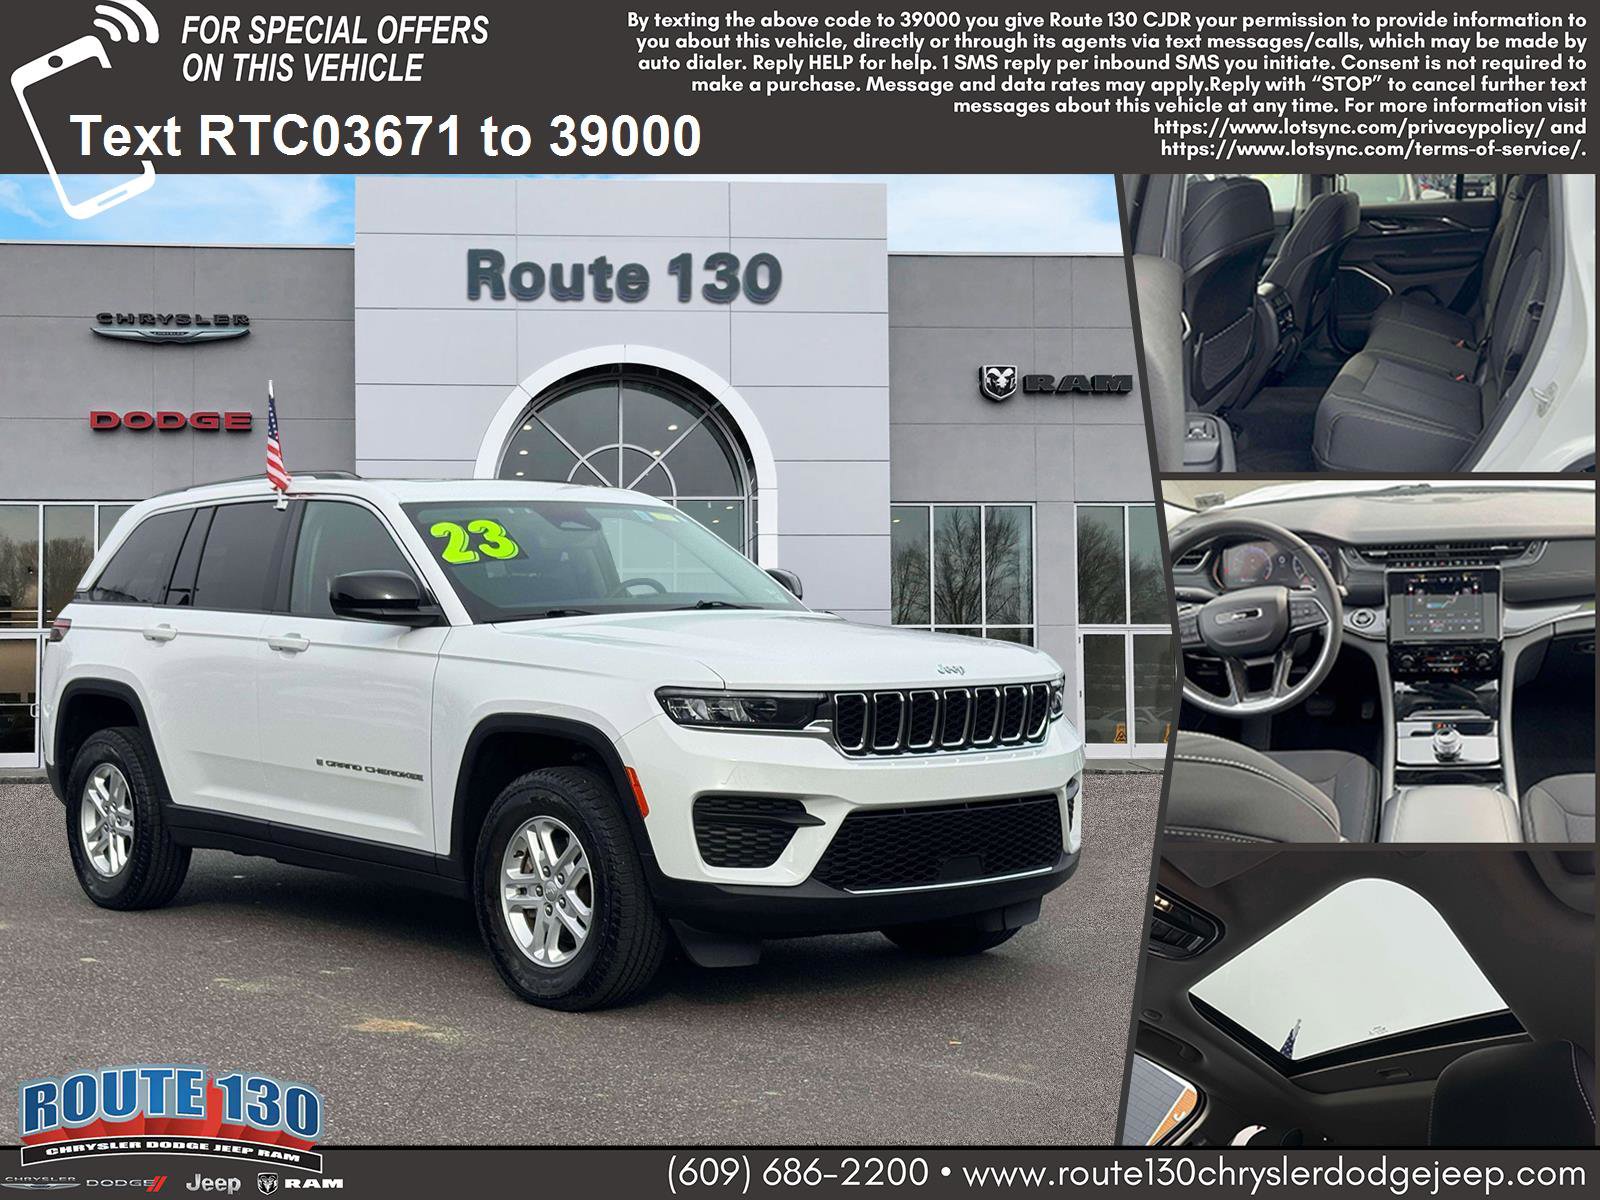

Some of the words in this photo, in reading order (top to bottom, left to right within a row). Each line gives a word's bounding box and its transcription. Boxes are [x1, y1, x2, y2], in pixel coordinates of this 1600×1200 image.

[467, 249, 650, 302] Route
[668, 252, 782, 304] 130
[96, 313, 250, 325] CHRYSLER
[1023, 374, 1133, 394] RAM
[90, 411, 252, 430] DODGE
[430, 519, 519, 564] 23
[325, 760, 363, 772] GRAND
[364, 766, 424, 782] CHEROKEE
